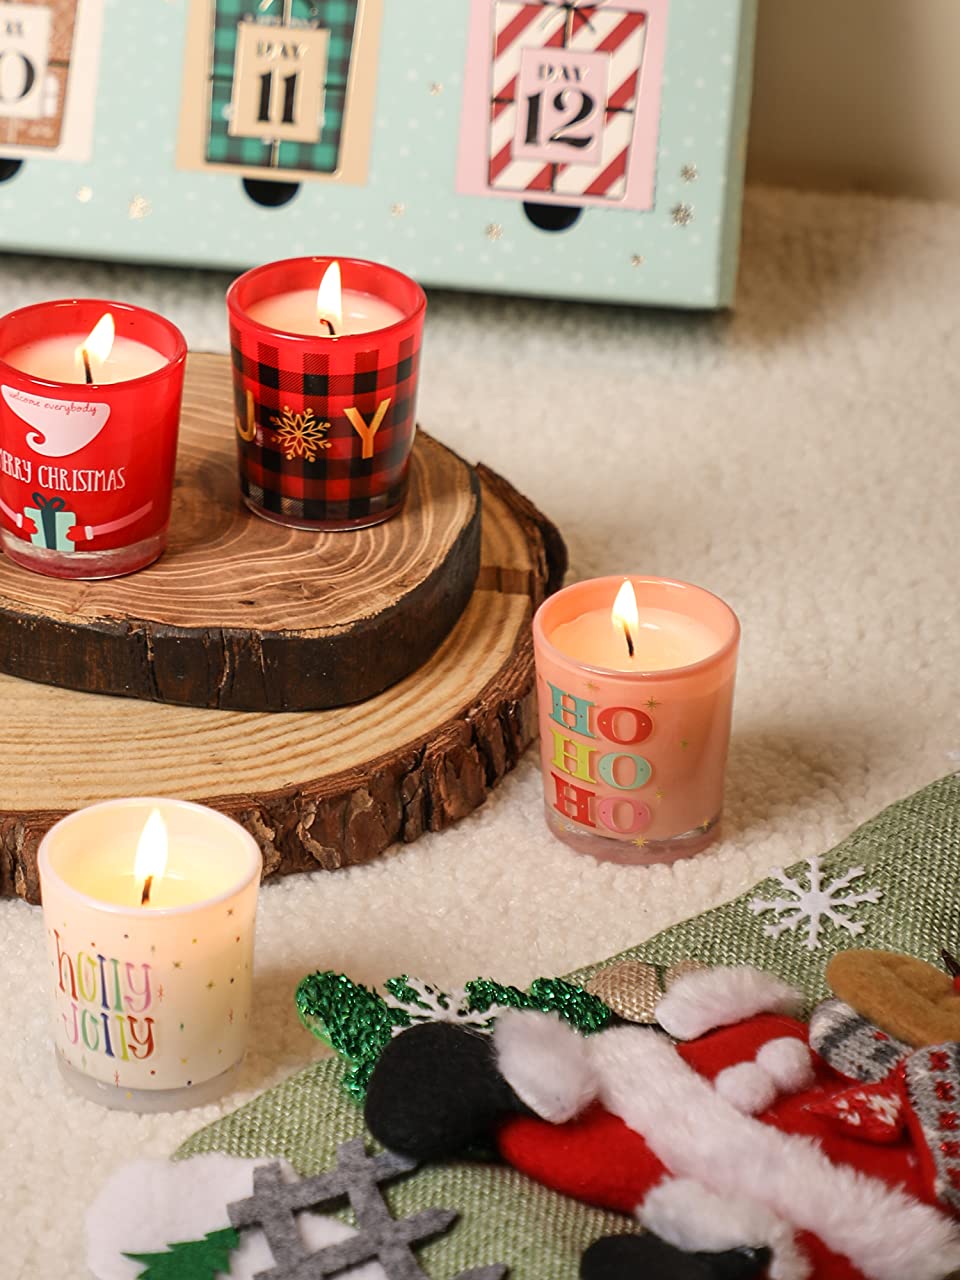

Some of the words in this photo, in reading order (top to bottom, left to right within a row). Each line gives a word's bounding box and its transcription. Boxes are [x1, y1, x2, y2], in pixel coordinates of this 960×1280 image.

[256, 70, 301, 125] 11
[538, 64, 590, 83] DAY
[524, 89, 595, 149] 12
[43, 402, 97, 417] everybody
[38, 465, 126, 492] CHRISTMAS
[546, 680, 653, 746] HO
[550, 727, 652, 790] HO
[550, 771, 651, 834] HO
[53, 928, 152, 1013] holly
